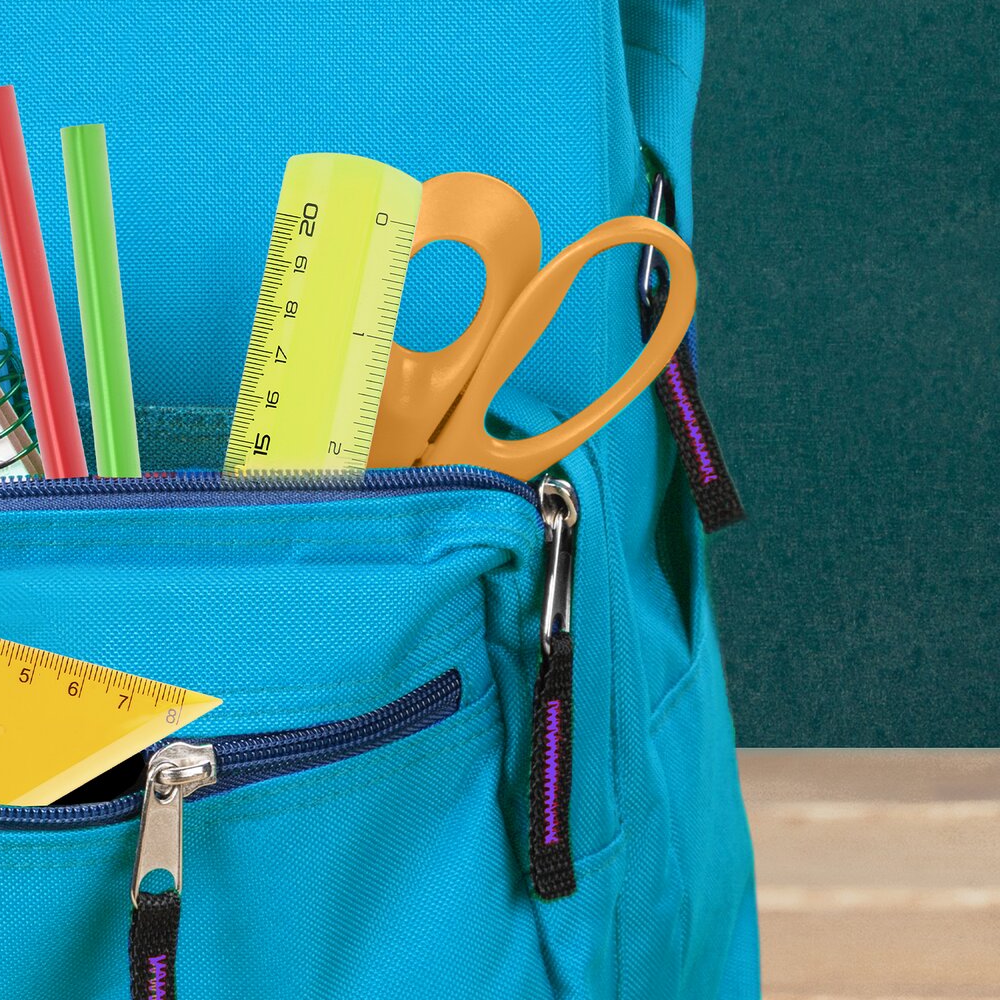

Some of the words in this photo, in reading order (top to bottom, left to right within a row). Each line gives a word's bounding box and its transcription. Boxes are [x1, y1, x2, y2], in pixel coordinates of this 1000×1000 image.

[299, 202, 319, 237] 20
[375, 212, 389, 226] 0
[293, 255, 308, 274] 19
[283, 300, 299, 319] 18
[274, 345, 289, 364] 17
[265, 390, 280, 409] 16
[253, 433, 271, 456] 15
[328, 441, 342, 455] 2
[18, 668, 31, 684] 5
[67, 681, 79, 697] 6
[117, 694, 129, 710] 7
[165, 708, 177, 724] 8
